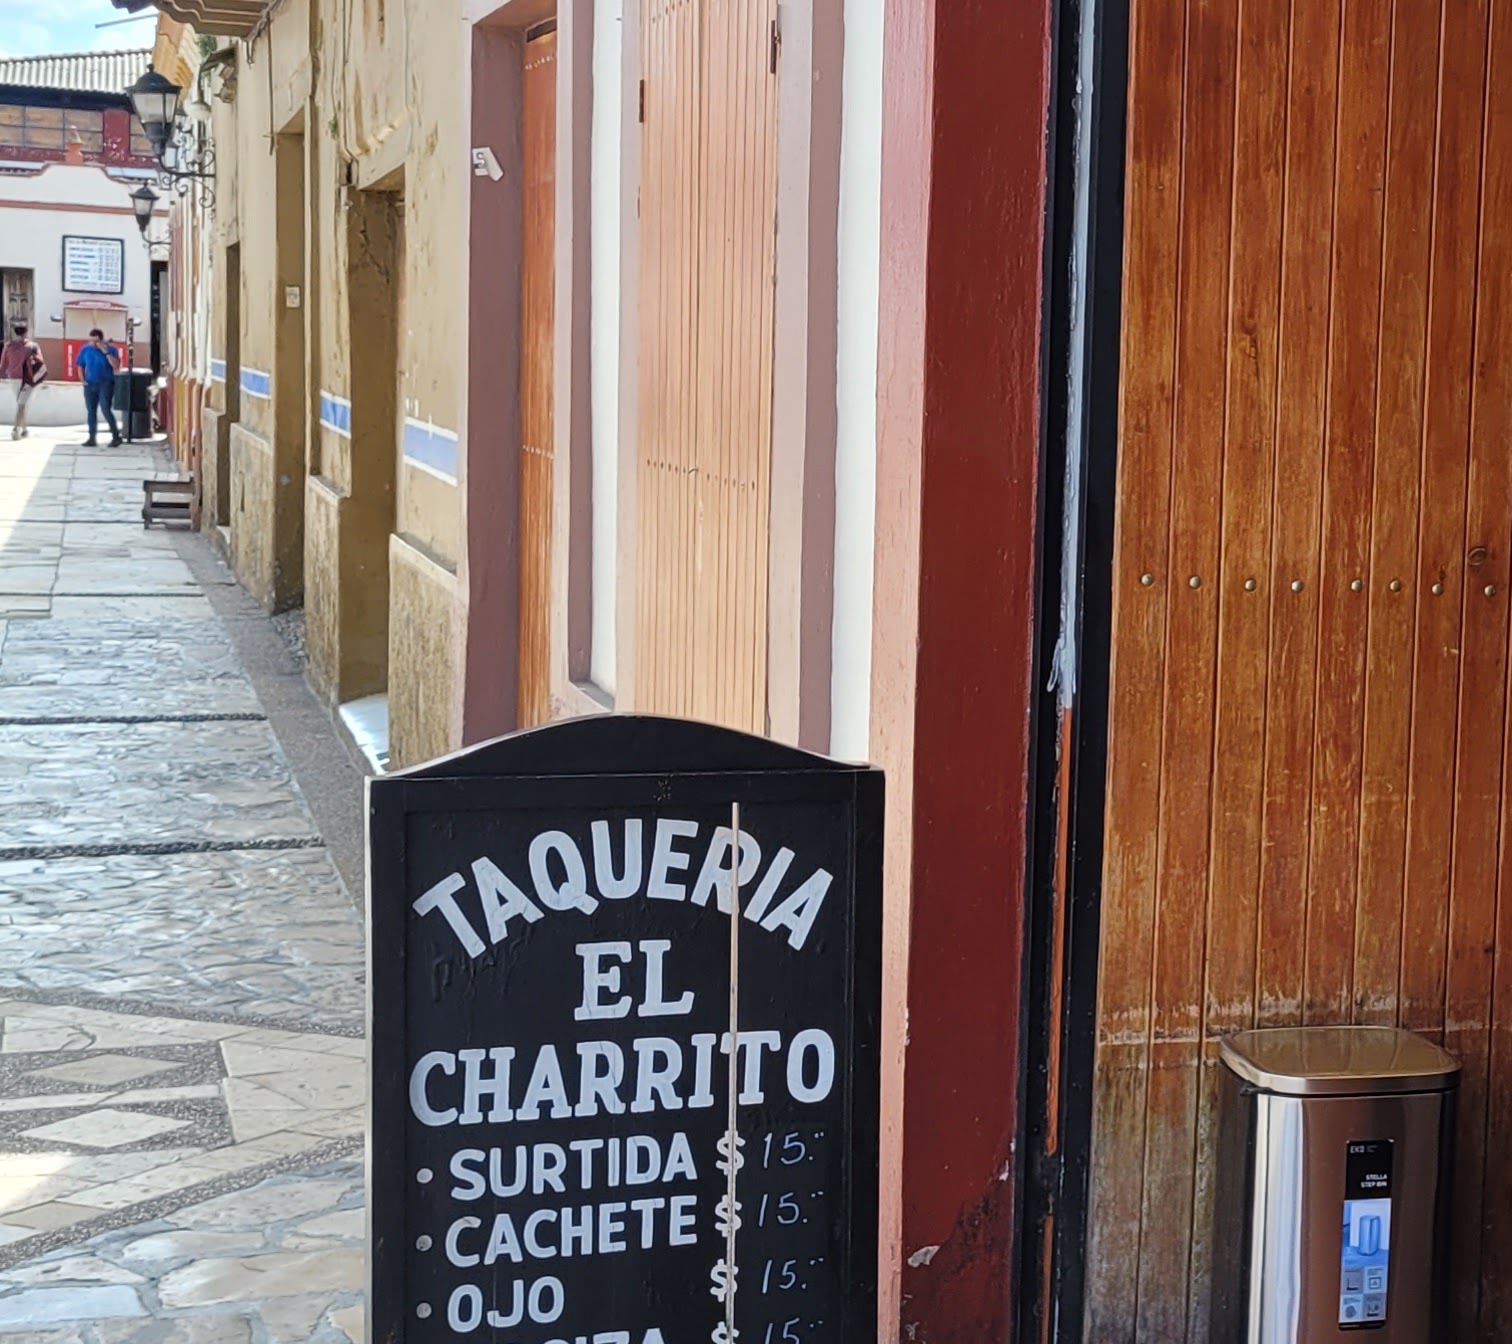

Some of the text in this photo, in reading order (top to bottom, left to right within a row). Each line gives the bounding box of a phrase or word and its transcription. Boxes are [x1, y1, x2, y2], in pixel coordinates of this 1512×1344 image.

[412, 818, 834, 959] TAQUERIA
[573, 939, 695, 1021] EL
[408, 1028, 836, 1127] CHARRITO
[449, 1132, 698, 1200] SURTIDA
[444, 1195, 698, 1268] CACHETE
[447, 1276, 565, 1333] OJO
